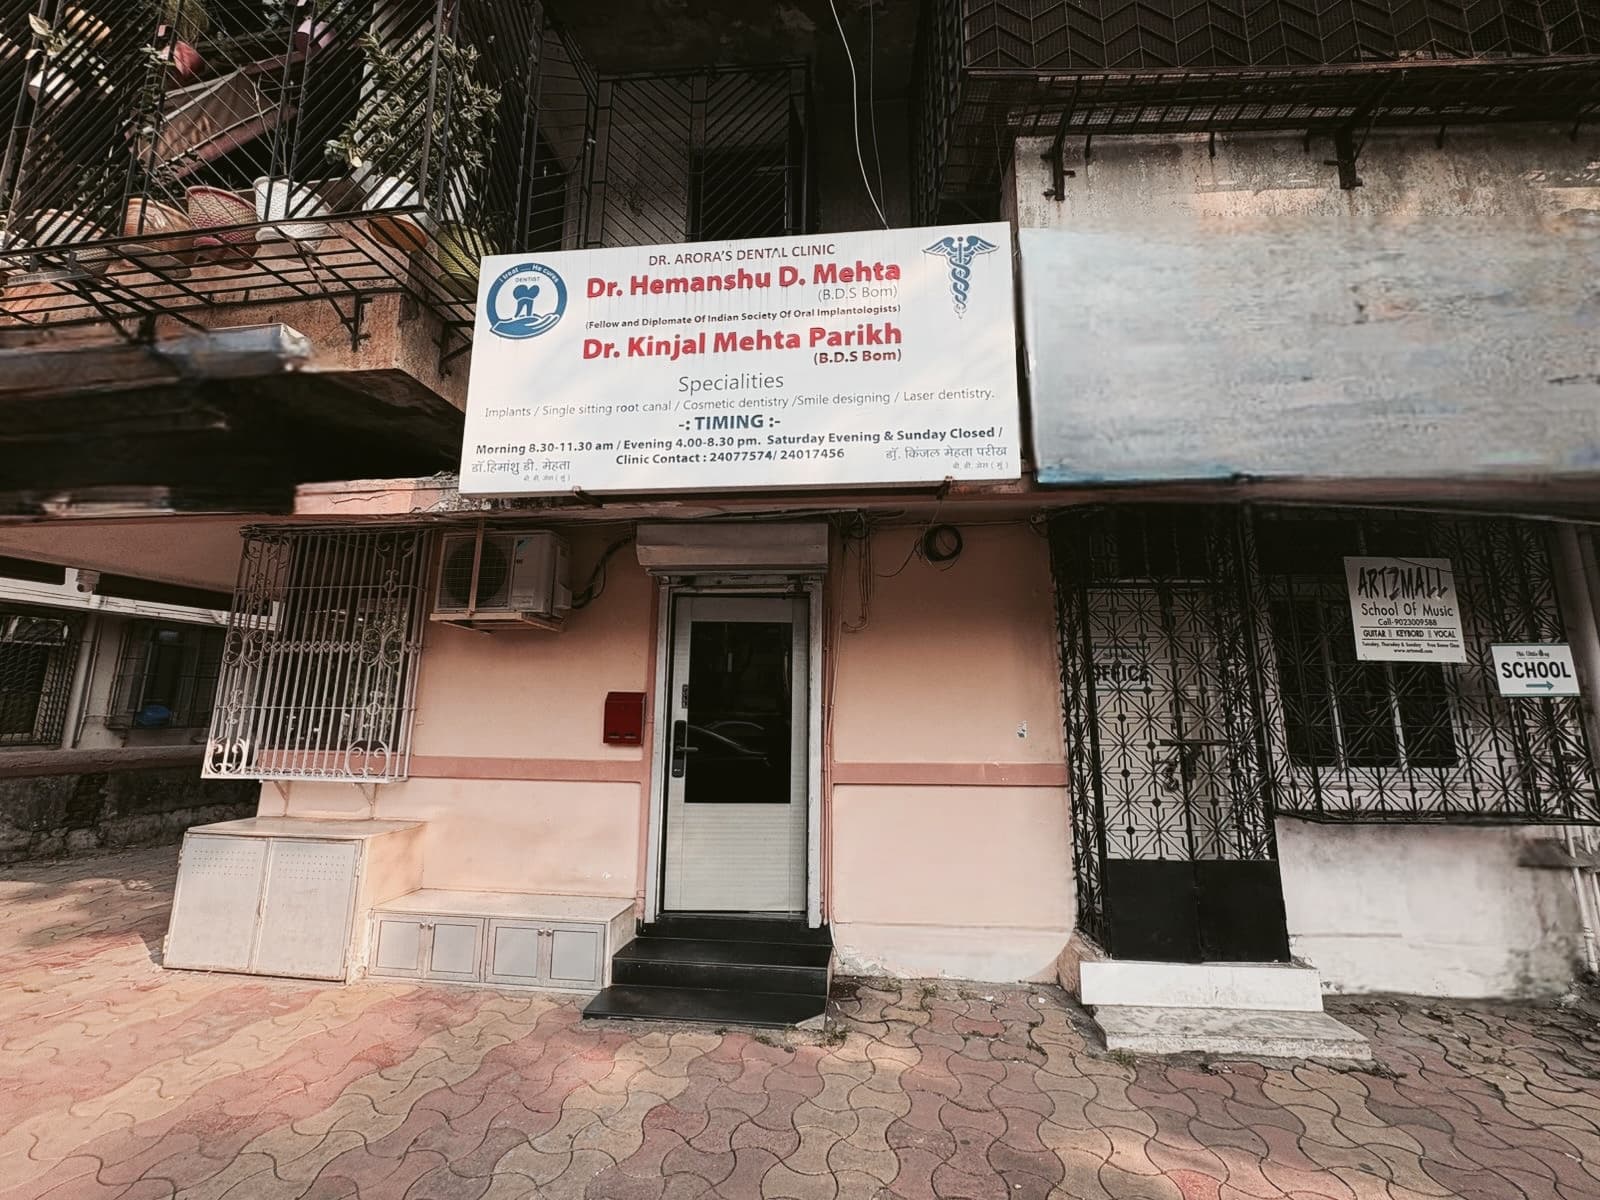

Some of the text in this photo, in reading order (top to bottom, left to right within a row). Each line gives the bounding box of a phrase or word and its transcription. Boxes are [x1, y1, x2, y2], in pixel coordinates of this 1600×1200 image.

[649, 244, 836, 266] DR. ARORA'S DENTAL CLINIC
[586, 260, 901, 299] Dr. Hemanshu D. Mehta
[818, 285, 897, 302] (B.D.S Bom)
[585, 304, 901, 330] (Fellow and Diplomate Of Indian Society Of Oral Implantologists)
[583, 322, 902, 361] Dr. Kinjal Mehta Parikh
[813, 348, 902, 366] (B.D.S Bom)
[678, 373, 784, 396] Specialities
[484, 406, 531, 418] Implants
[542, 405, 576, 417] Single
[578, 403, 612, 416] sitting
[616, 403, 639, 413] root
[642, 400, 671, 412] canal
[683, 398, 735, 410] Cosmetic
[738, 396, 788, 409] dentistry
[832, 391, 890, 406] designing
[903, 390, 934, 402] Laser
[938, 387, 995, 401] dentistry.
[694, 414, 764, 431] TIMING
[475, 443, 526, 455] Morning
[528, 441, 592, 453] 8.30-11.30
[595, 442, 614, 451] am
[623, 438, 672, 451] Evening
[675, 436, 734, 449] 4.00-8.30
[737, 437, 761, 448] pm.
[767, 433, 824, 445] Saturday
[828, 431, 880, 444] Evening
[884, 430, 894, 441] &
[897, 429, 946, 441] Sunday
[950, 427, 995, 439] Closed
[616, 454, 649, 465] Clinic
[652, 453, 700, 464] Contact
[780, 448, 845, 460] 24017456
[905, 446, 939, 459] किंजल
[944, 445, 972, 458] मेहता
[976, 444, 1008, 457] परीख
[542, 458, 570, 471] मेहता
[1357, 566, 1448, 601] ARTZMALL
[1361, 601, 1454, 617] School Of Music
[1362, 629, 1387, 638] GUITAR
[1433, 629, 1457, 639] VOCAL
[1501, 661, 1572, 679] SCHOOL
